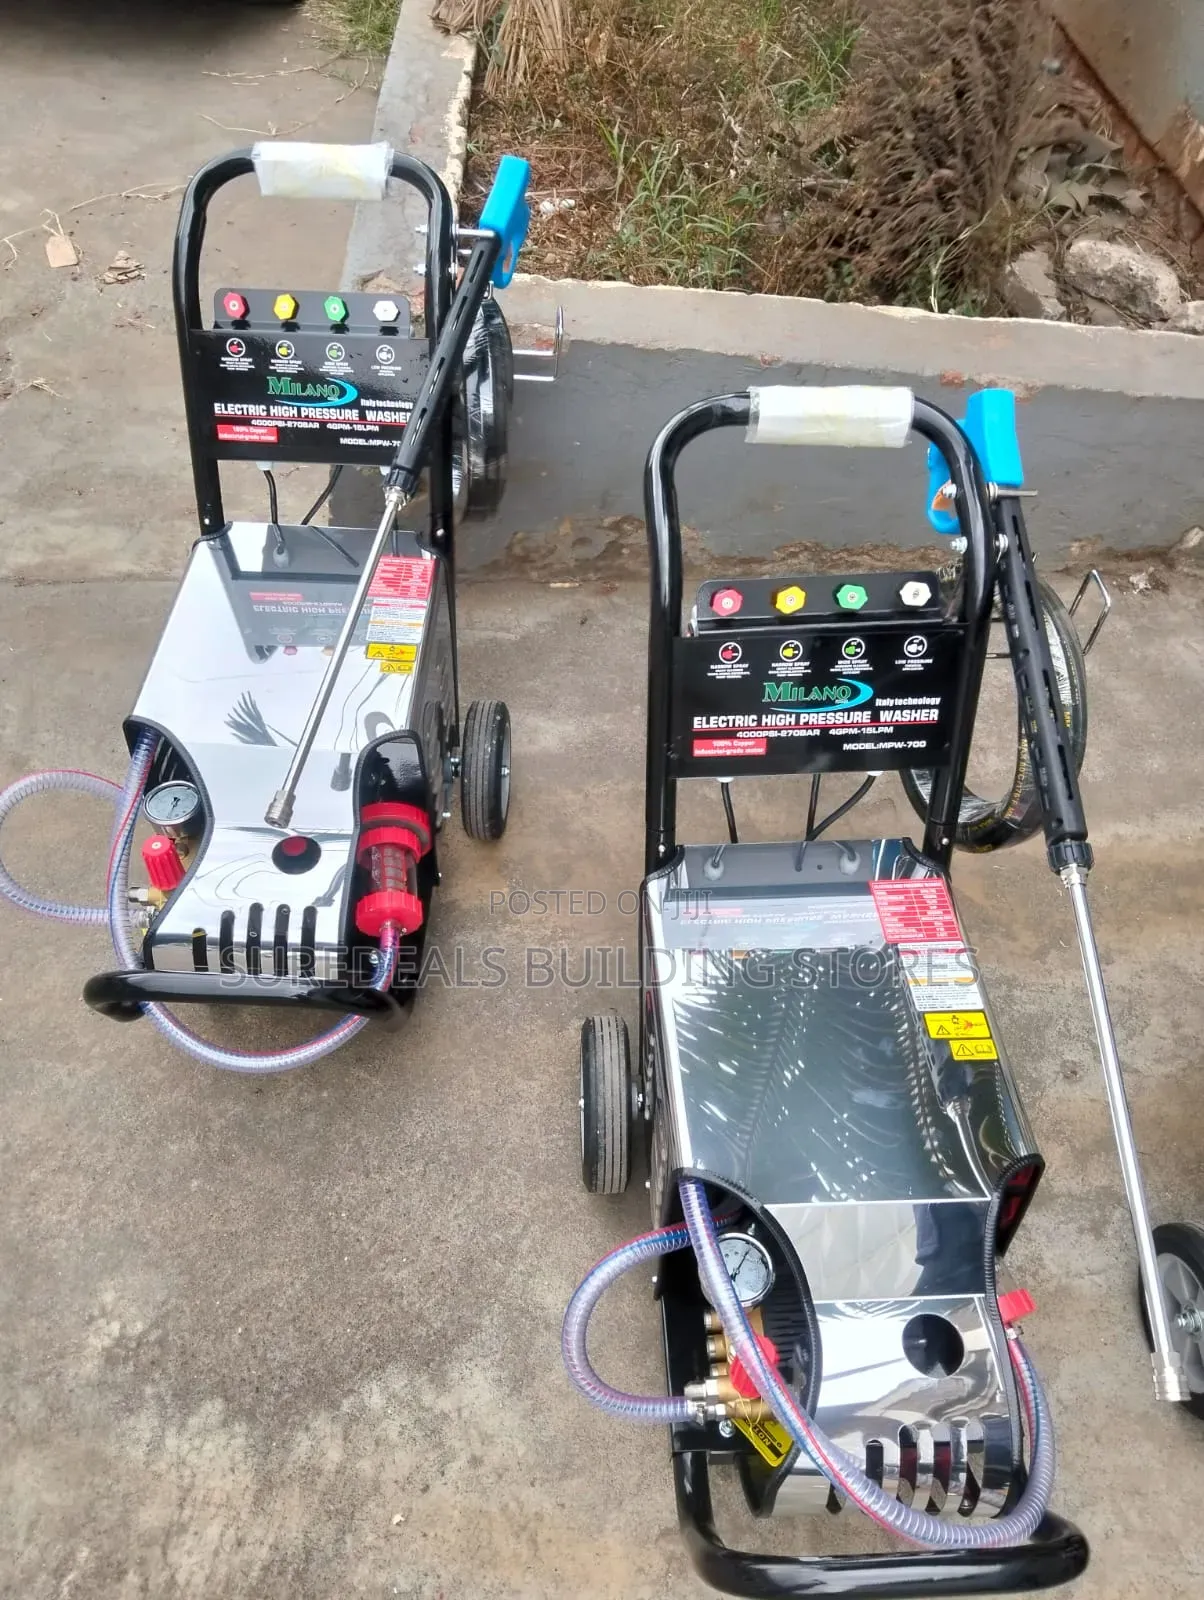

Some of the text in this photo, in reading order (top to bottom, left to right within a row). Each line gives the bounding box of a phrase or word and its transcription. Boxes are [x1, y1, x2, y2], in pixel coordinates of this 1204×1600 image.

[266, 376, 340, 398] MILANO
[213, 403, 267, 415] ELECTRIC
[269, 405, 298, 417] HIGH
[301, 407, 359, 420] PRESSURE
[762, 681, 851, 702] MILANO
[693, 709, 939, 729] ELECTRIC HIGH PRESSURE WASHER
[736, 726, 894, 738] 4000PSI-270BAR 4GPM-15LPM
[843, 741, 927, 750] MODEL:MPW-700
